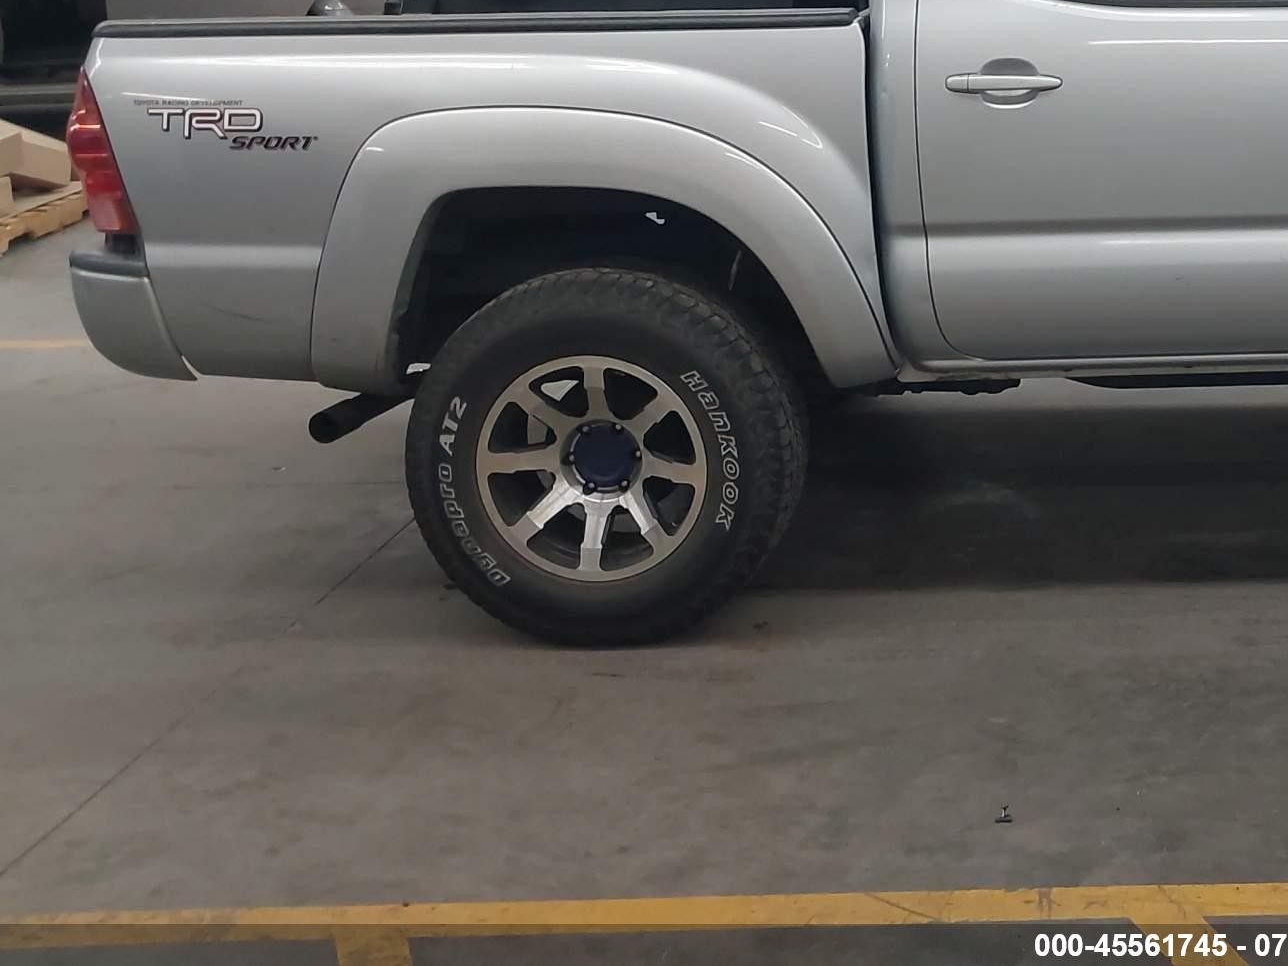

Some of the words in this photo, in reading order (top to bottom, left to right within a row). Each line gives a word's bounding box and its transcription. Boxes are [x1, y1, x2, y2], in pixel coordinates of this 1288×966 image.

[147, 107, 264, 140] TRD
[229, 136, 315, 151] SPORT
[438, 396, 468, 457] AT2
